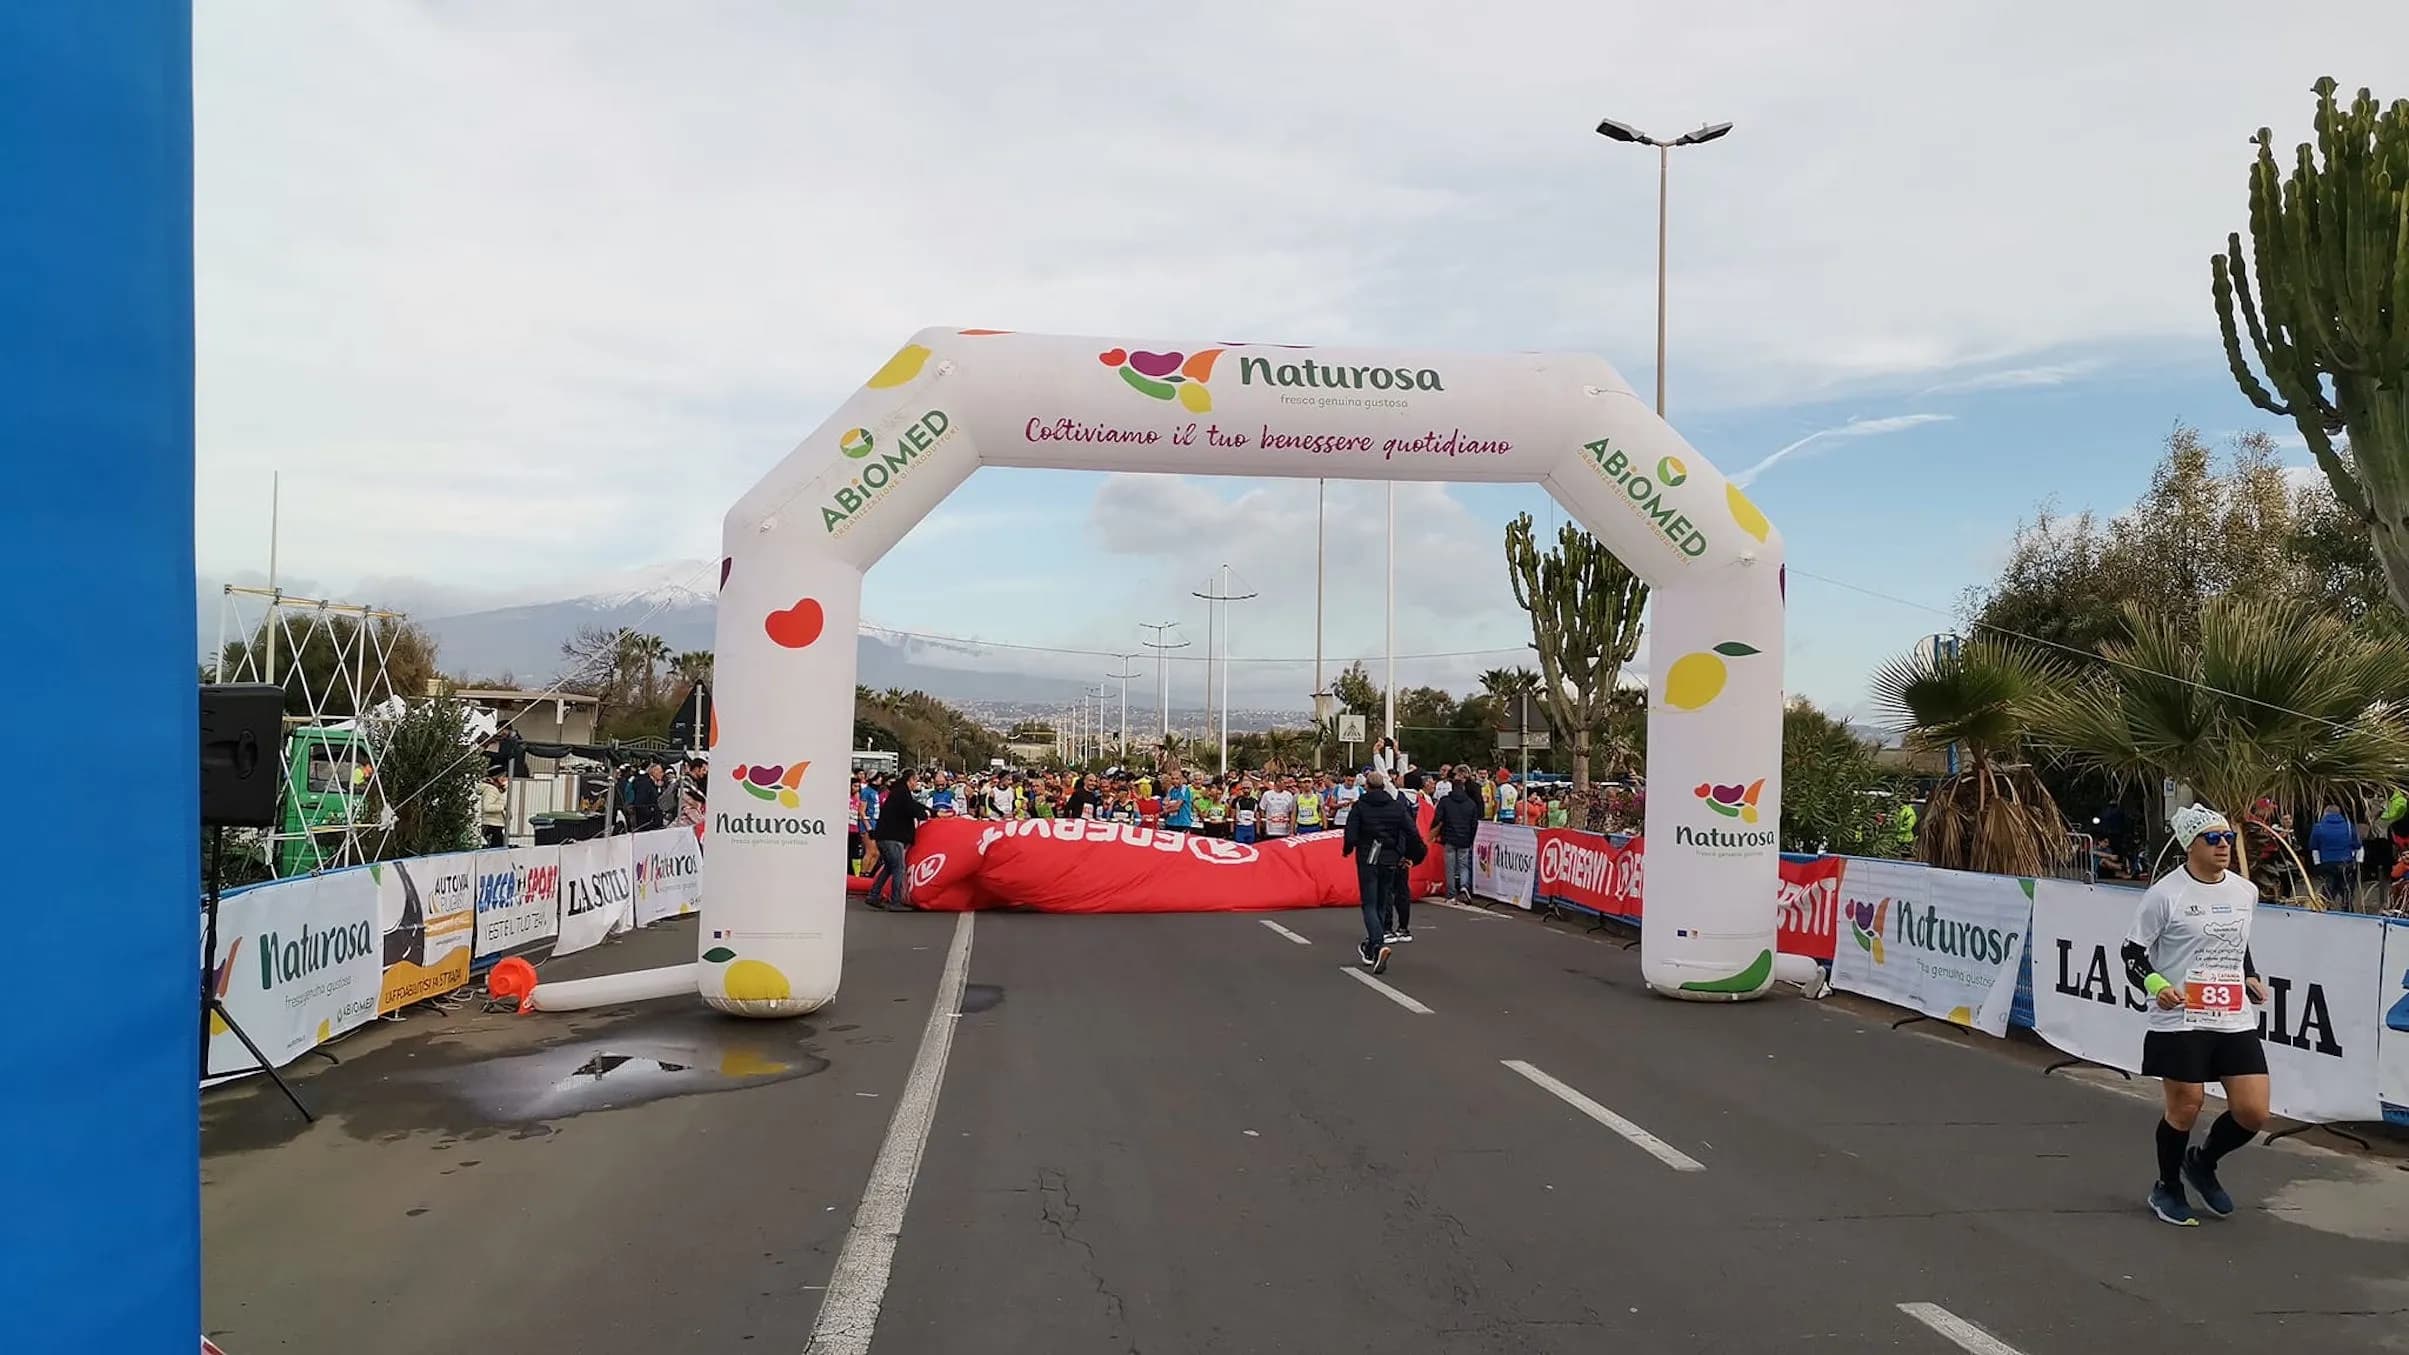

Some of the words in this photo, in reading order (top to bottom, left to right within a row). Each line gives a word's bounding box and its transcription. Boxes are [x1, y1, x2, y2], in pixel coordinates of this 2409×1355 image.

[1280, 393, 1316, 406] fresca
[1318, 395, 1362, 409] genuina
[1364, 397, 1409, 410] gustosa
[1025, 416, 1163, 445] Coltiviamo
[1173, 423, 1198, 446] il
[1206, 424, 1251, 448] tuo
[1260, 424, 1375, 454] benessere
[1383, 428, 1513, 460] quotidiano
[2056, 938, 2117, 1005] LA
[2202, 986, 2231, 1004] 83
